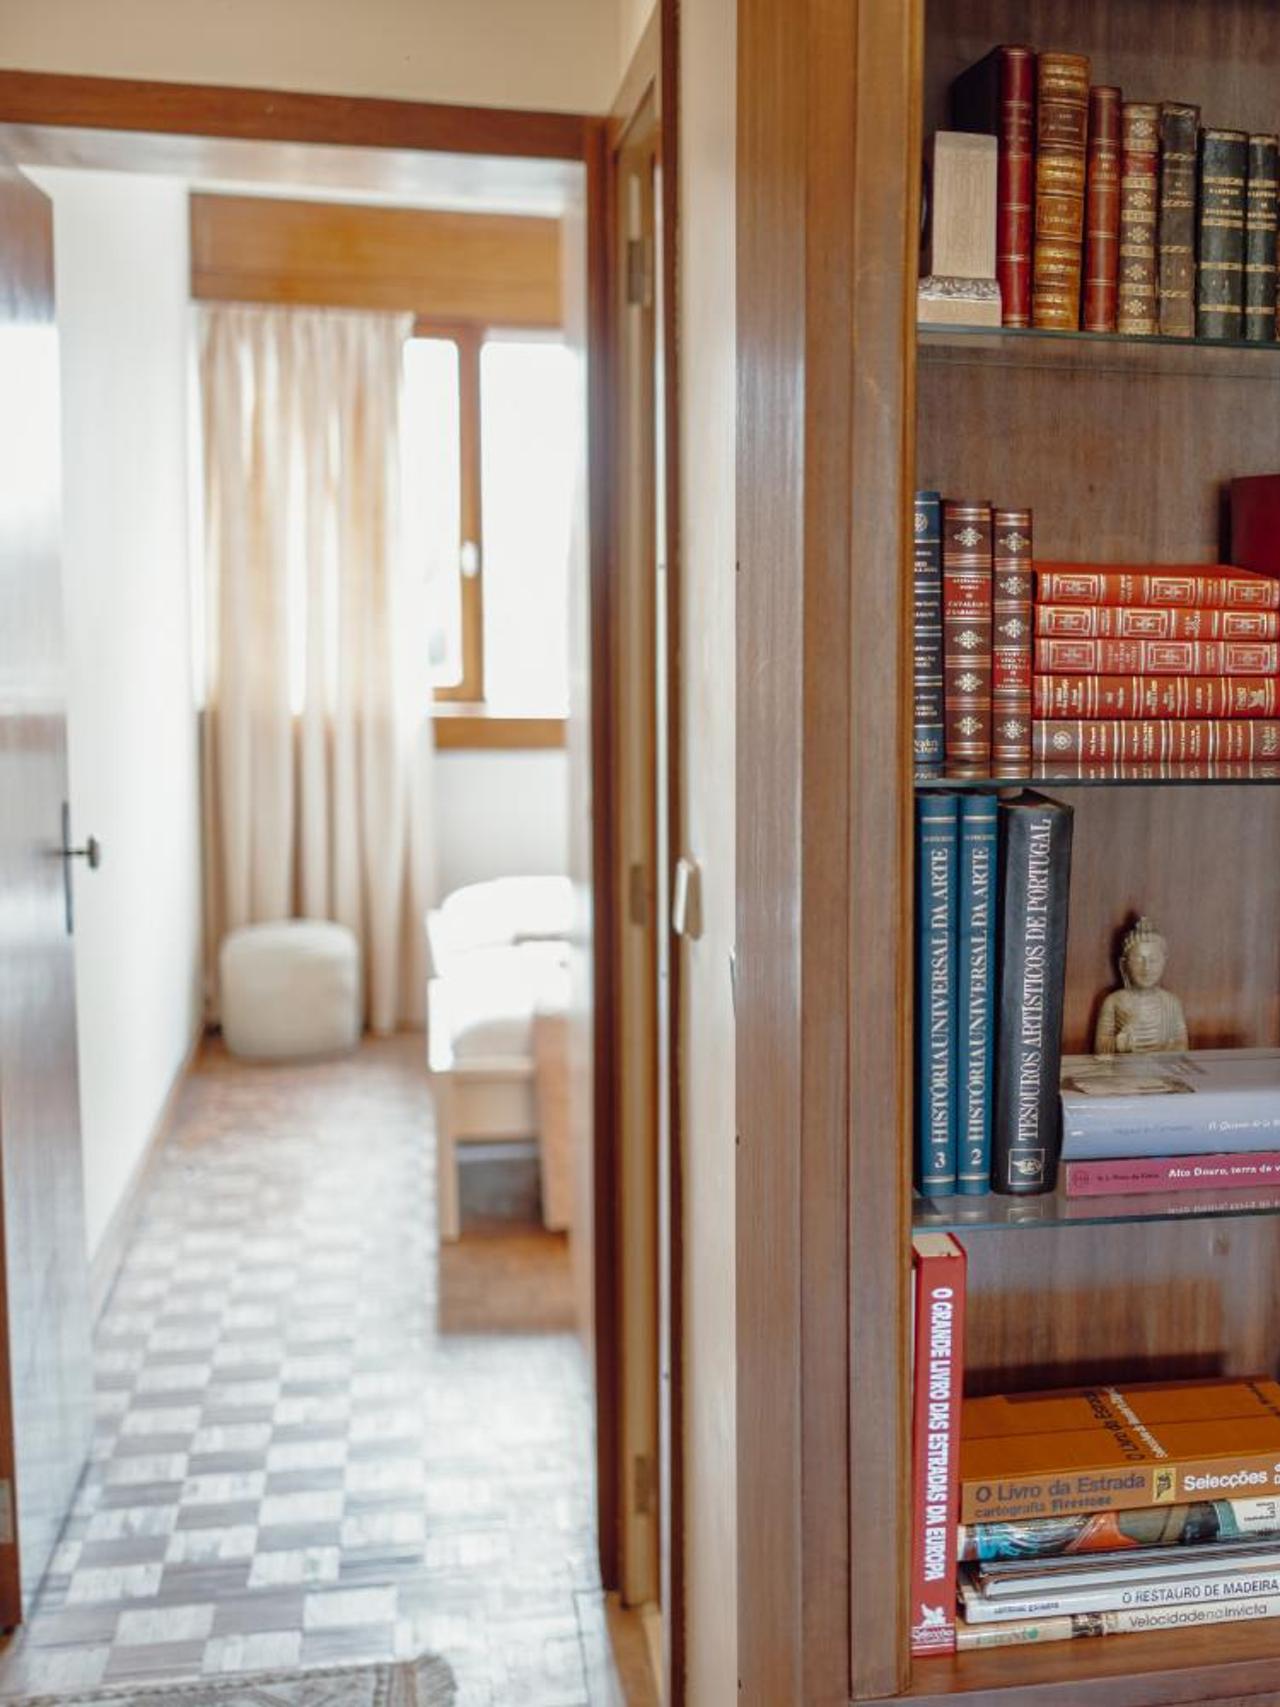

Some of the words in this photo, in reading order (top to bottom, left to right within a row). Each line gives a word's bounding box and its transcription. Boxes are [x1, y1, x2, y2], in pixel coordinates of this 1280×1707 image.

[931, 848, 949, 900] ARTE
[971, 847, 989, 898] ARTE
[1027, 818, 1052, 913] PORTUGAL
[931, 903, 949, 929] DA
[971, 902, 988, 927] DA
[1025, 915, 1047, 941] DE
[931, 931, 949, 1048] UNIVERSAL
[969, 929, 987, 1046] UNIVERSAL
[1022, 944, 1046, 1048] ARTÍSTICOS
[930, 1050, 949, 1143] HISTÓRIA
[966, 1048, 986, 1141] HISTÓRIA
[1018, 1051, 1041, 1142] TESOUROS
[934, 1151, 946, 1169] 3
[970, 1148, 982, 1166] 2
[1168, 1167, 1191, 1178] Alto
[1194, 1165, 1229, 1177] Douro,
[1231, 1164, 1257, 1175] terra
[1259, 1162, 1273, 1174] de
[932, 1287, 953, 1299] O
[931, 1302, 953, 1358] GRANDE
[930, 1360, 951, 1400] LIVRO
[928, 1402, 949, 1431] DAS
[926, 1433, 949, 1503] ESTRADAS
[1183, 1470, 1268, 1491] Selecções
[976, 1486, 991, 1502] O
[998, 1485, 1041, 1502] Livro
[1048, 1479, 1070, 1496] da
[1078, 1473, 1145, 1493] Estrada
[925, 1505, 947, 1525] DA
[975, 1502, 1045, 1518] cartografia
[924, 1527, 946, 1582] EUROPA
[1122, 1590, 1131, 1604] O
[1136, 1586, 1200, 1602] RESTAURO
[1204, 1584, 1219, 1597] DE
[1223, 1579, 1279, 1595] MADEIRA
[1129, 1608, 1204, 1627] Velocidade
[1223, 1604, 1268, 1618] Invicta
